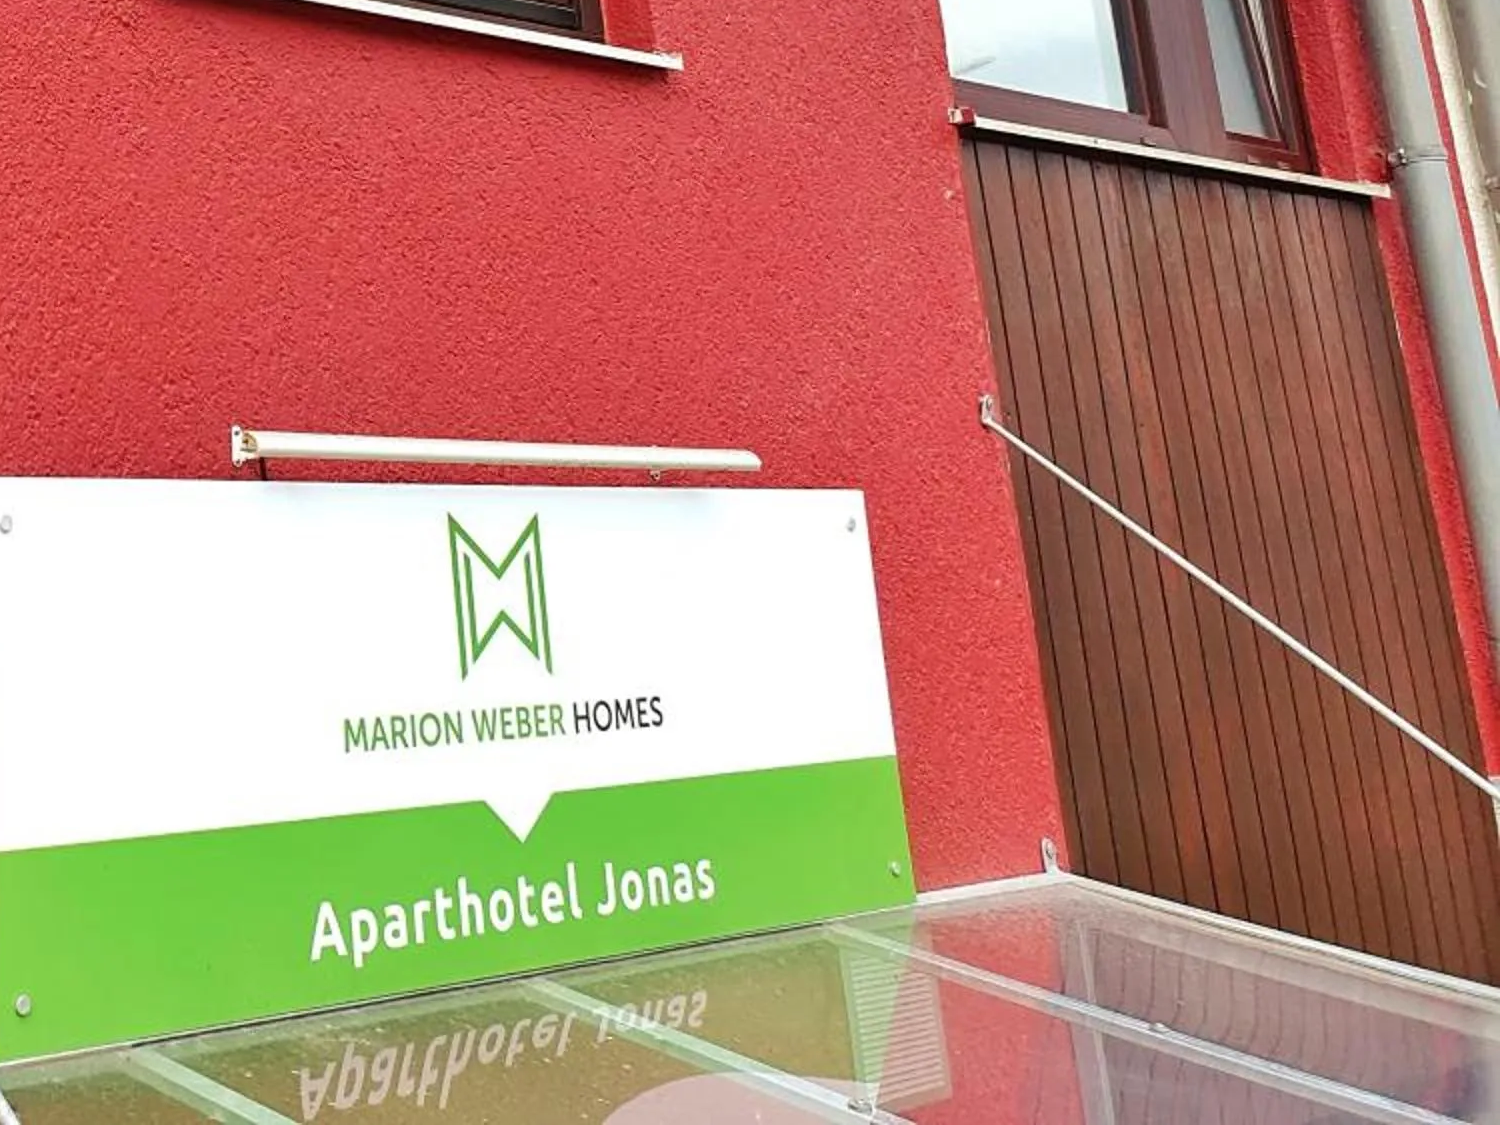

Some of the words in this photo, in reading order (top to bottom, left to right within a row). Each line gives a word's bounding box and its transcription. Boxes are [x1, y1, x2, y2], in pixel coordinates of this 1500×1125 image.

[343, 710, 464, 754] MARION
[471, 703, 566, 743] WEBER
[572, 695, 664, 735] HOMES
[311, 862, 583, 968] Aparthotel
[597, 859, 716, 915] Jonas
